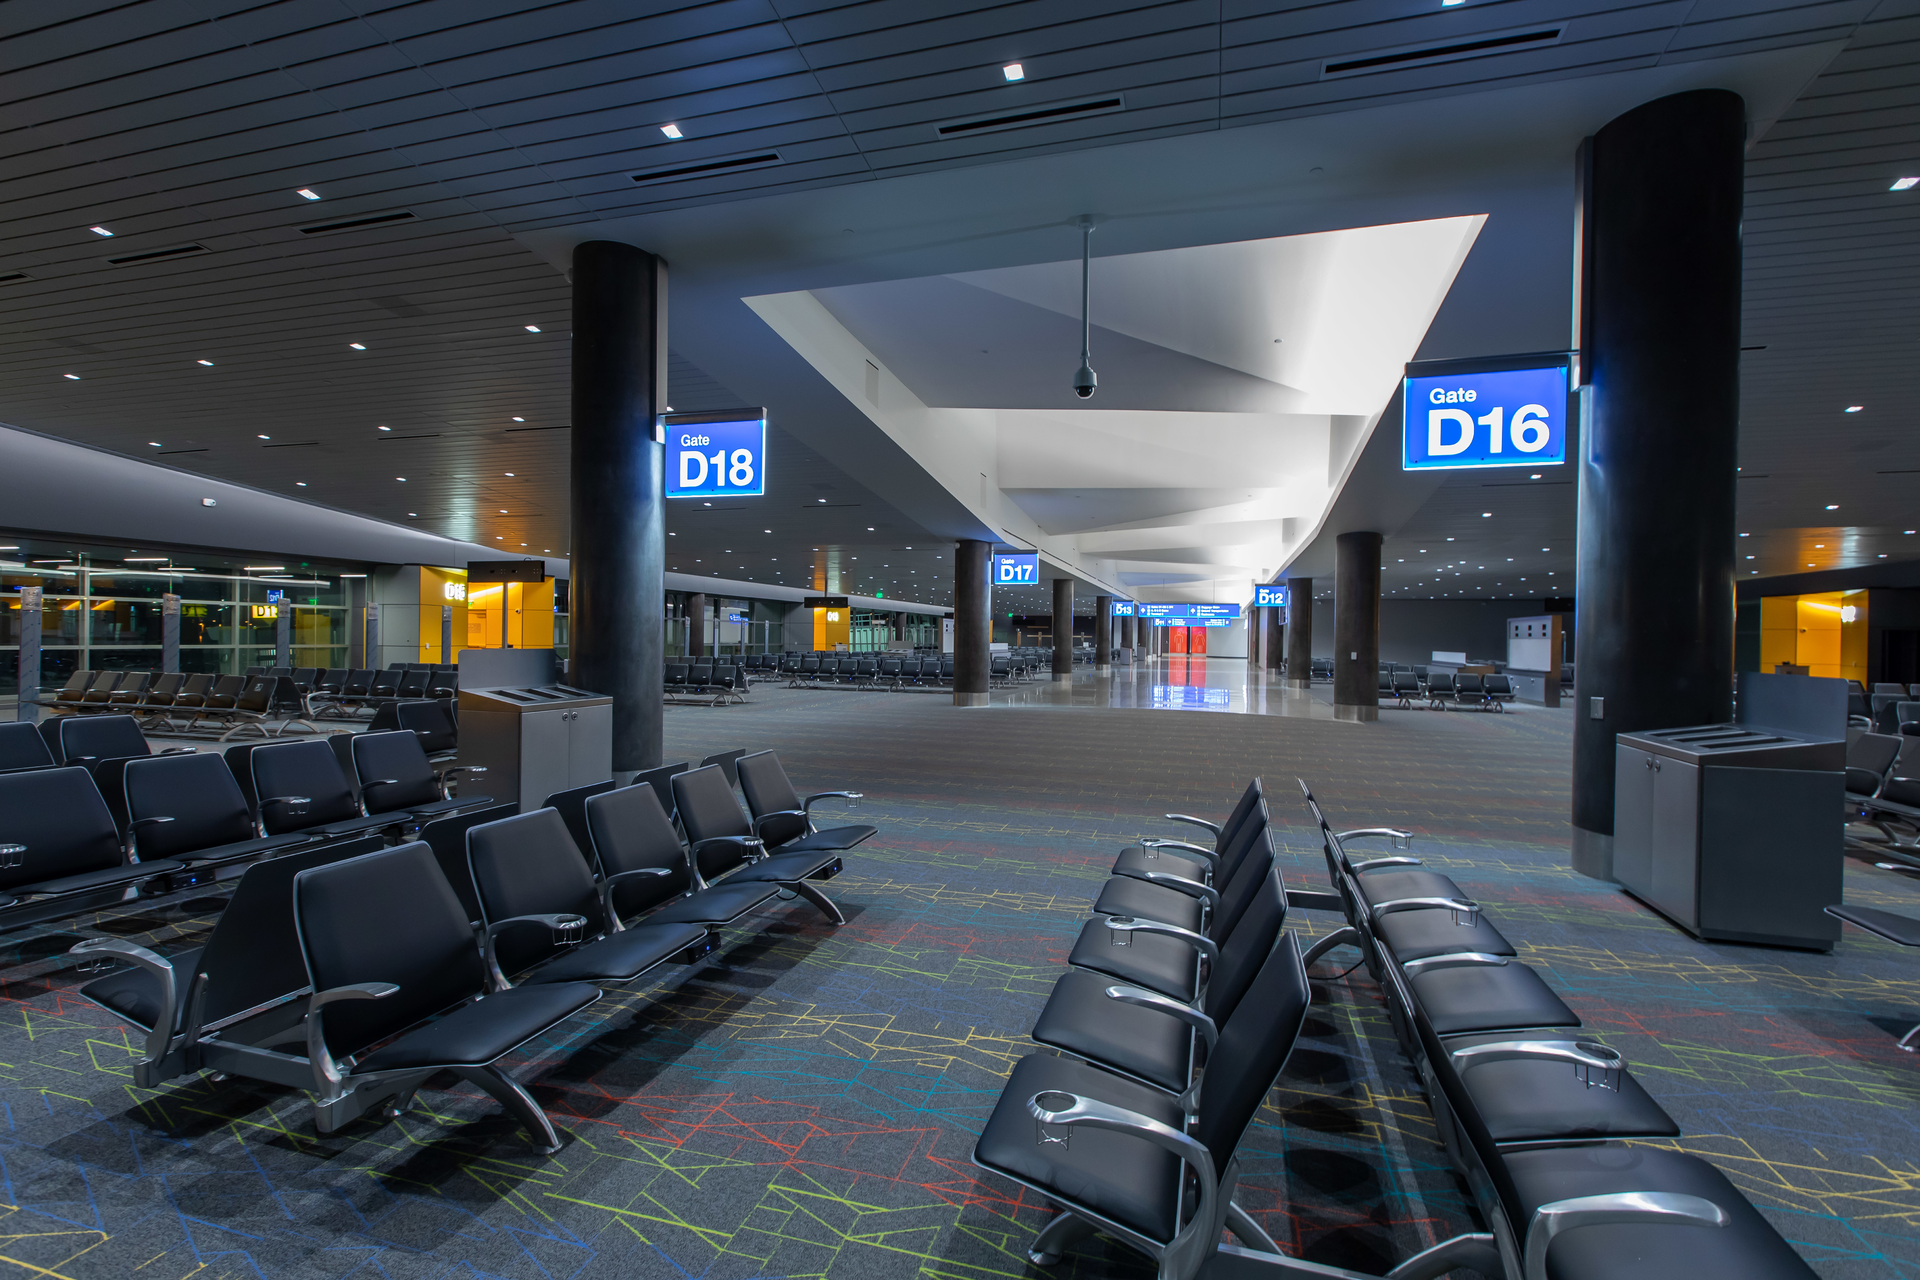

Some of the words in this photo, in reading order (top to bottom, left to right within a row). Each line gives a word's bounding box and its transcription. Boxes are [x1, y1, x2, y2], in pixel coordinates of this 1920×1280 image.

[1429, 387, 1477, 404] Gate
[1428, 404, 1550, 456] D16
[680, 434, 710, 447] Gate
[679, 448, 754, 488] D18
[1000, 565, 1033, 581] D17
[1259, 592, 1283, 604] D12
[1116, 606, 1133, 615] D13
